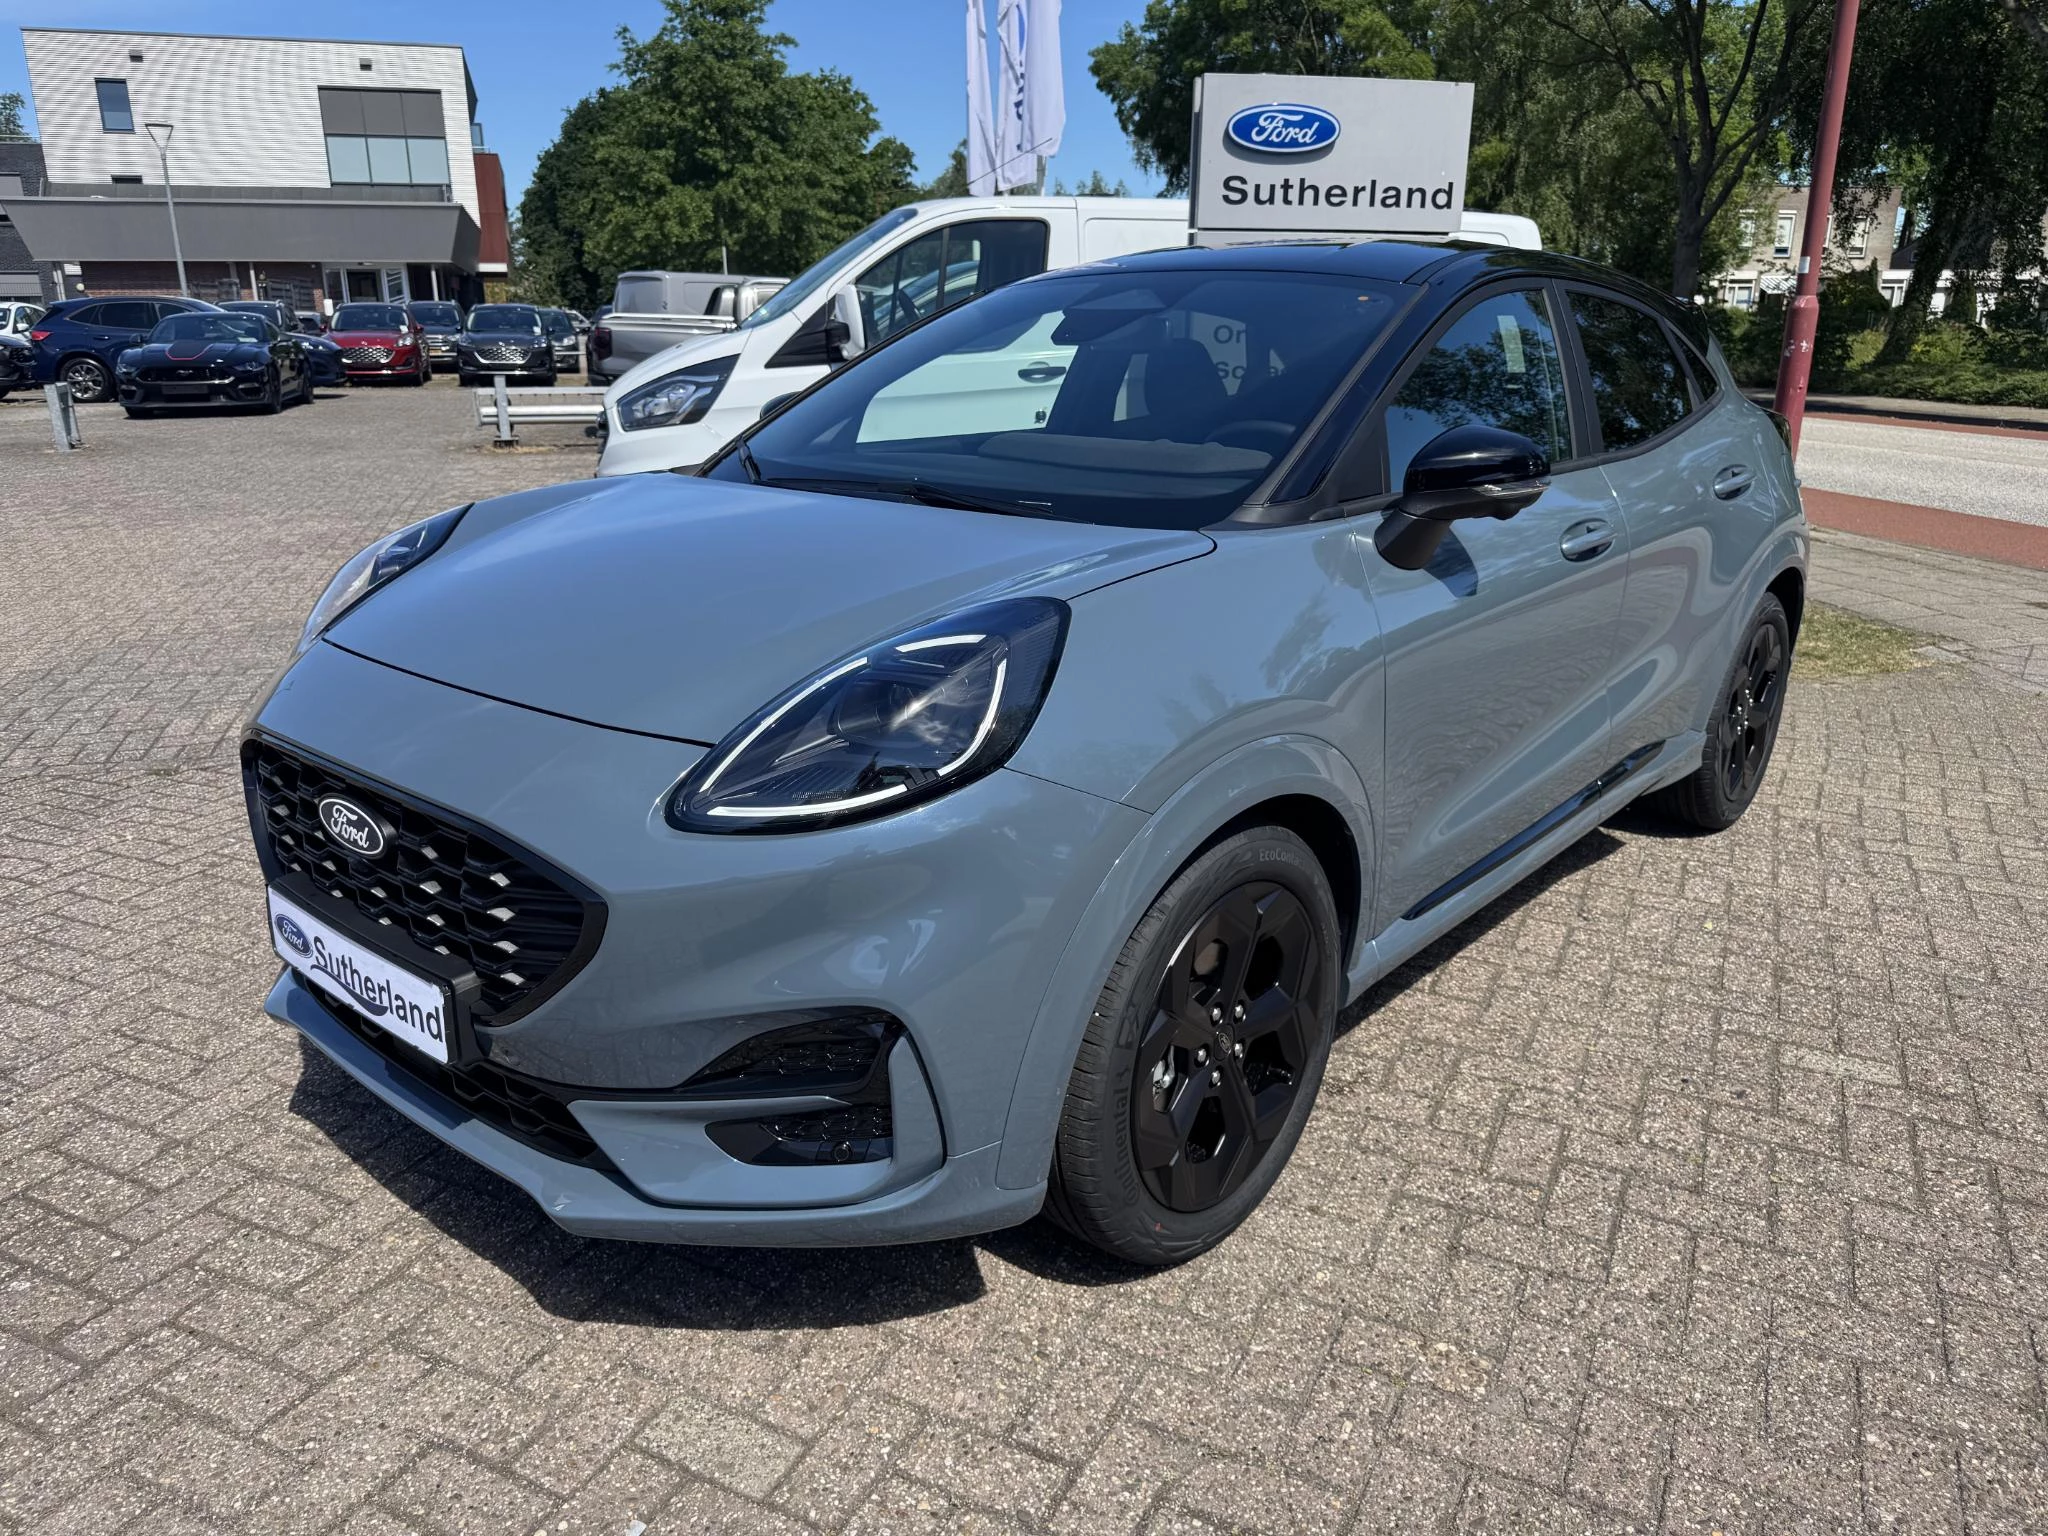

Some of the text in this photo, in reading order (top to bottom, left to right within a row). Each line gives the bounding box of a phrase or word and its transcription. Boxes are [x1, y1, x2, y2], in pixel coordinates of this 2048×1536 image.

[1251, 112, 1320, 144] Ford
[1222, 175, 1454, 210] Sutherland
[330, 805, 370, 849] Ford
[282, 920, 444, 1043] Ford Sutherland
